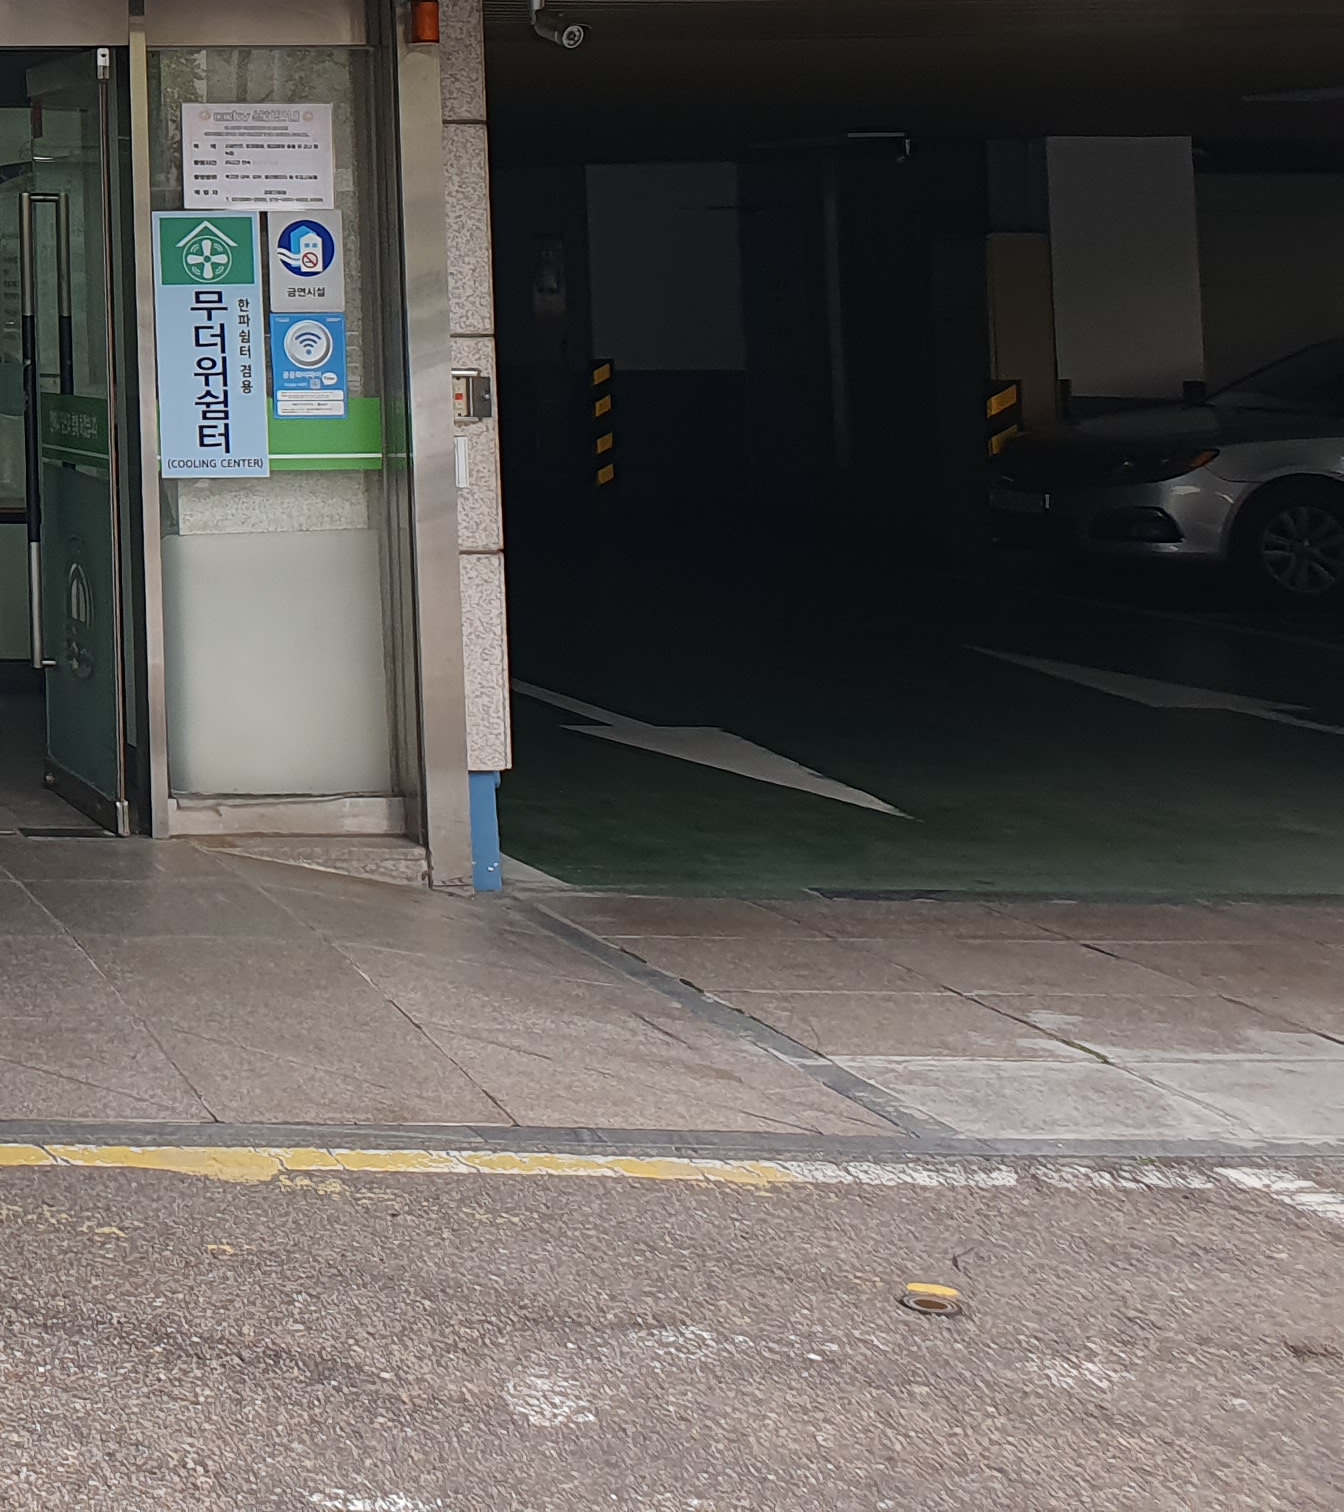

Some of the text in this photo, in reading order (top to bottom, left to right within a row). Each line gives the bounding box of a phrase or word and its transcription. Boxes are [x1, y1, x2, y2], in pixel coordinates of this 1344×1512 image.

[190, 290, 231, 454] 무더위쉼터
[238, 298, 253, 394] 한파쉼터 겸용
[167, 457, 264, 469] (COOLING CENTER)
